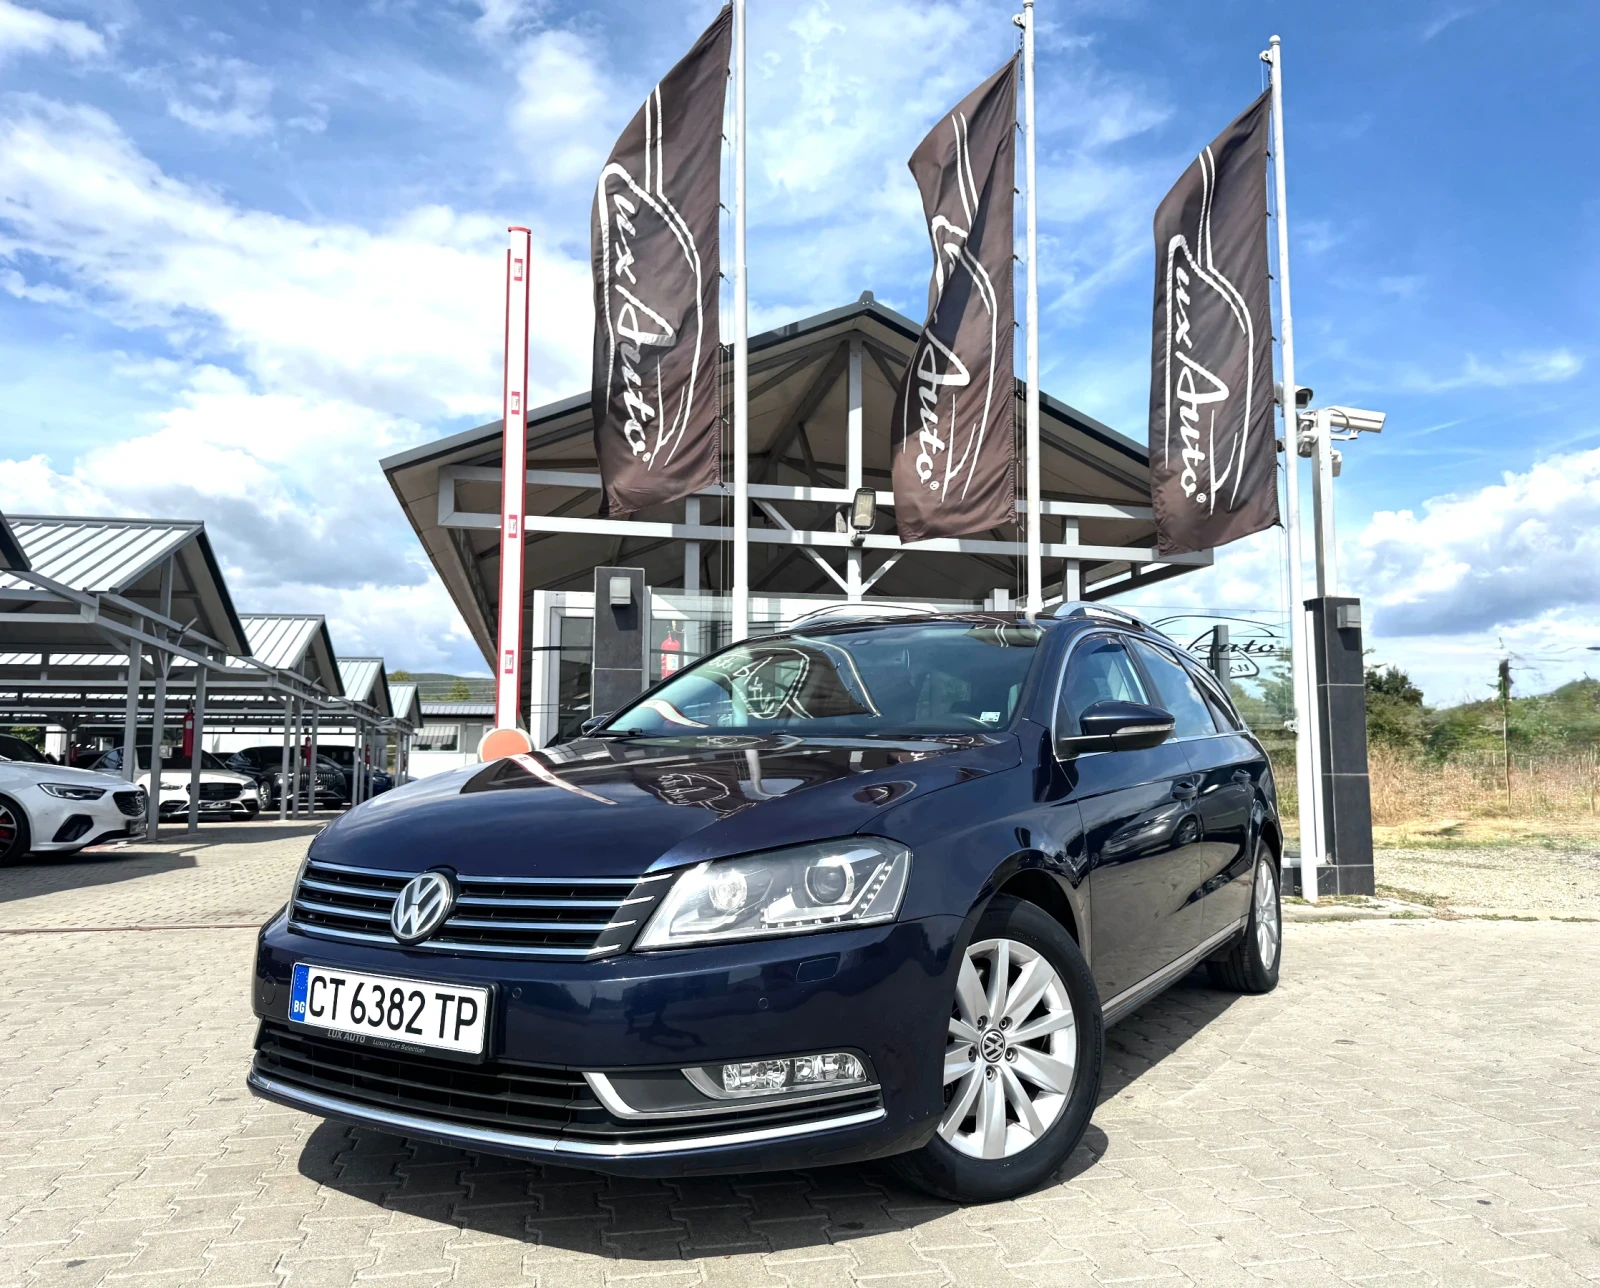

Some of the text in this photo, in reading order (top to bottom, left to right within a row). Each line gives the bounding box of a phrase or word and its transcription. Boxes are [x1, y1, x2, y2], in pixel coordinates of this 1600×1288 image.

[293, 999, 305, 1013] BG
[309, 976, 478, 1041] CT 6382 TP
[327, 1029, 366, 1043] LUX AUTO
